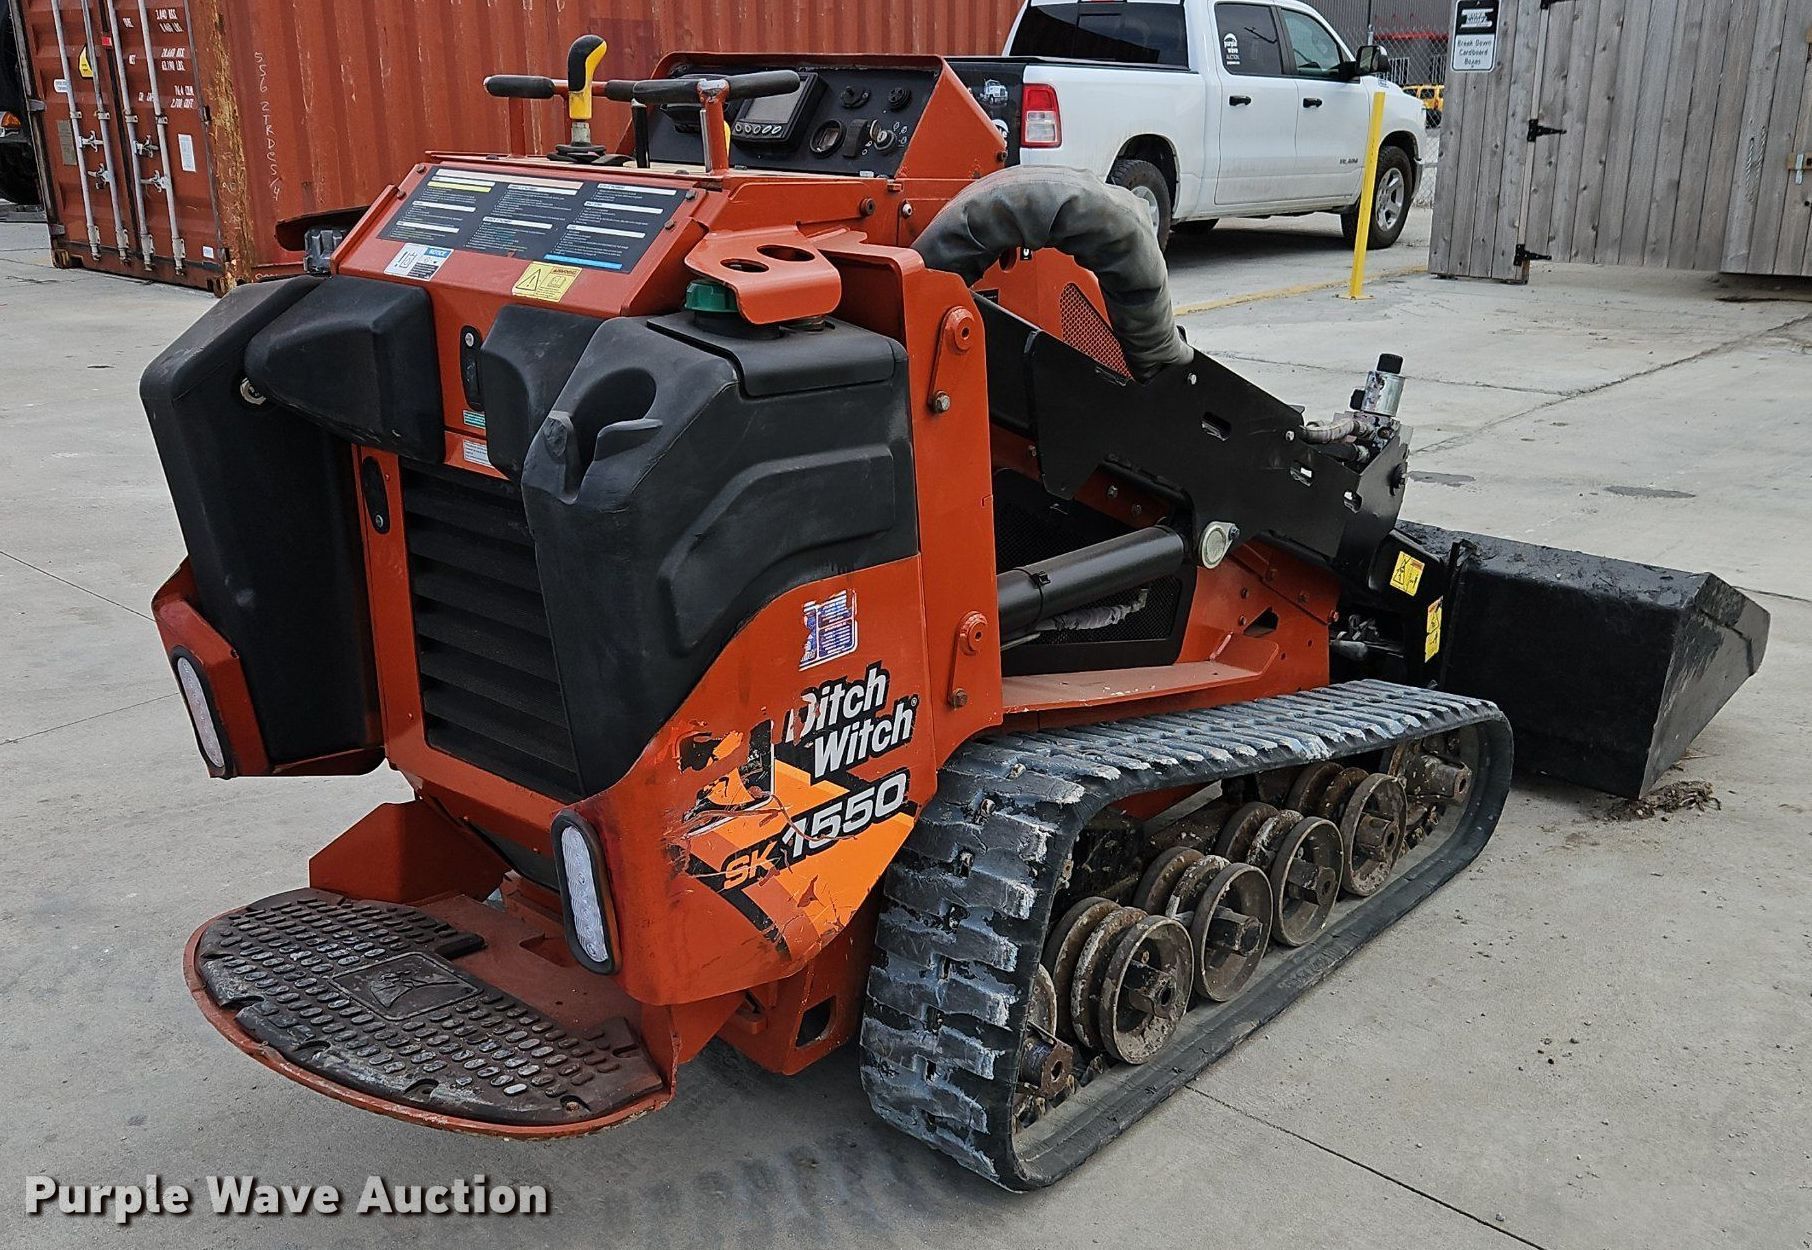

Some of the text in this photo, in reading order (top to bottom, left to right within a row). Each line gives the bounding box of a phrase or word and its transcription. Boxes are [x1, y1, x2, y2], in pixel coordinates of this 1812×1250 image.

[1457, 39, 1492, 48] Break Down
[785, 667, 886, 743] Ditch
[723, 773, 907, 890] SK 1550
